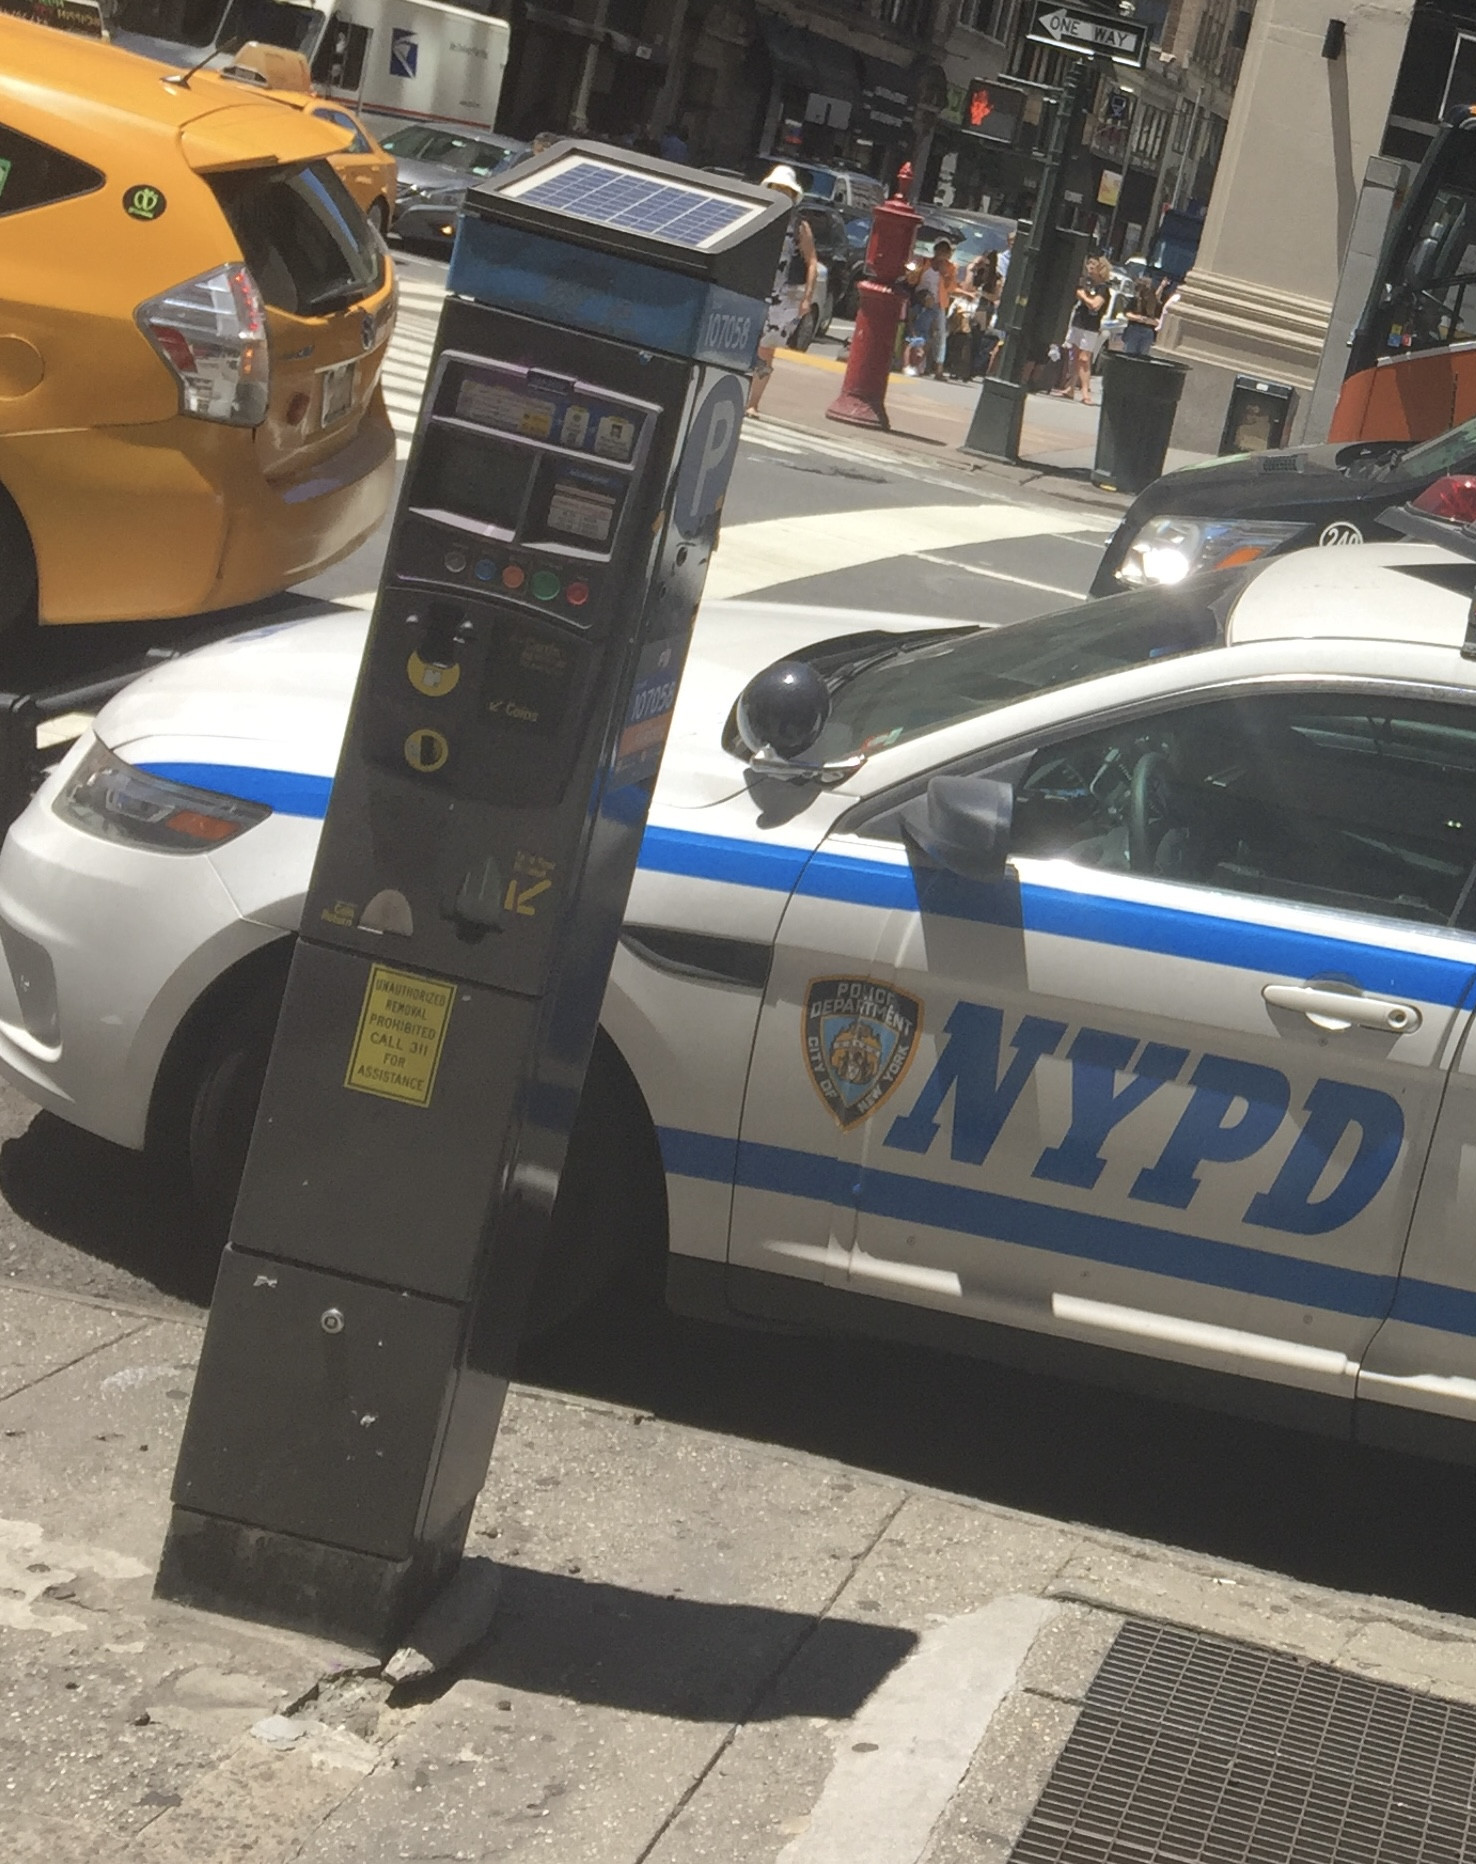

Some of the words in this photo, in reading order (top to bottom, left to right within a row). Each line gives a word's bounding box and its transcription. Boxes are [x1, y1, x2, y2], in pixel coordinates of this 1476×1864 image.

[1049, 15, 1081, 35] ONE
[1094, 26, 1128, 47] WAY
[704, 312, 751, 350] 107058
[690, 400, 735, 518] P
[375, 979, 446, 1007] UNAUTHORIZED
[837, 983, 896, 1006] POLICE
[385, 999, 427, 1020] REMOVAL
[810, 998, 913, 1036] DEPARTMENT
[368, 1013, 436, 1040] PROHIBITED
[370, 1032, 404, 1051] CALL
[409, 1041, 429, 1057] 311
[383, 1053, 406, 1068] FOR
[808, 1036, 826, 1073] CITY
[820, 1080, 838, 1099] OF
[357, 1065, 425, 1091] ASSISTANCE
[857, 1084, 883, 1114] NEW
[882, 1044, 910, 1083] YORK
[882, 1000, 1406, 1236] NYPD
